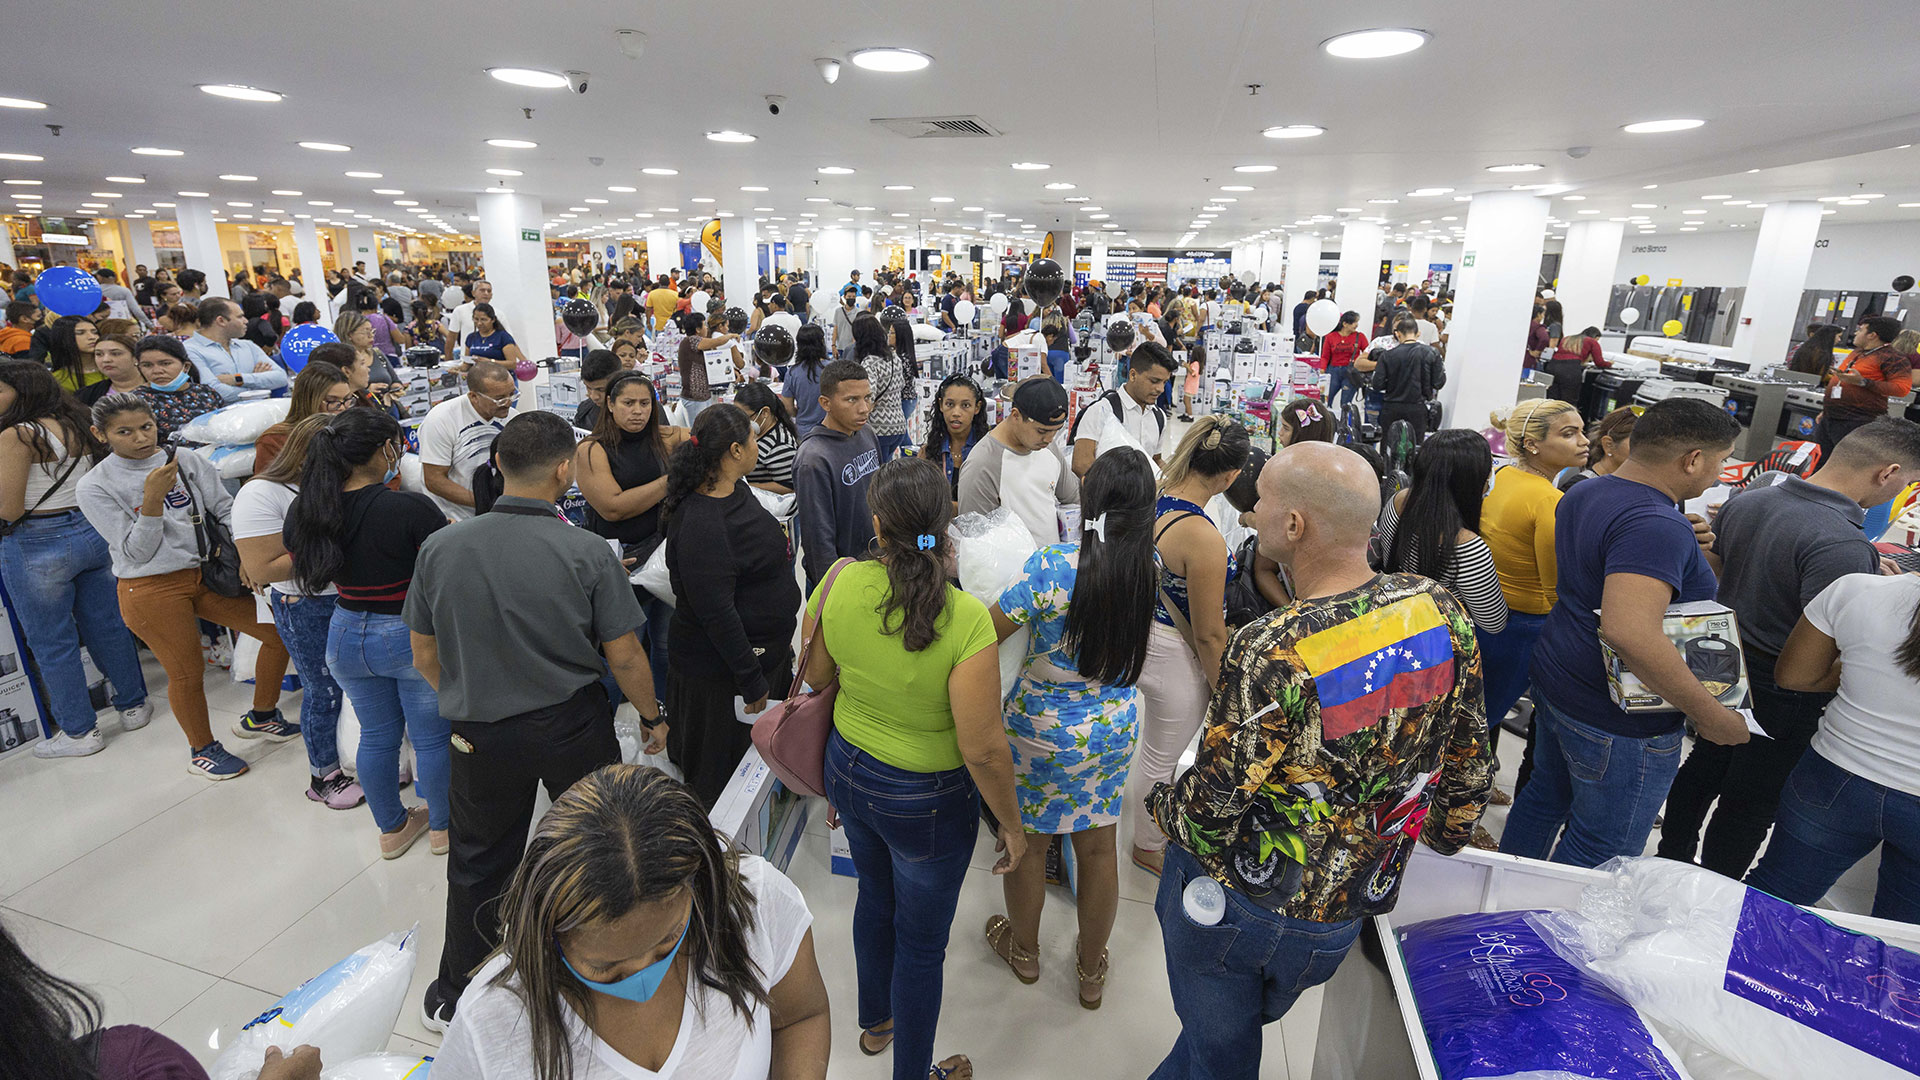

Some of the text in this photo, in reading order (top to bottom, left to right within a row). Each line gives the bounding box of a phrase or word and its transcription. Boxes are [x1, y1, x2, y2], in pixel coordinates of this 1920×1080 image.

[1815, 240, 1829, 248] ca
[1647, 245, 1667, 253] Blanca
[563, 499, 587, 510] Oster
[1744, 980, 1819, 1017] Export Quality
